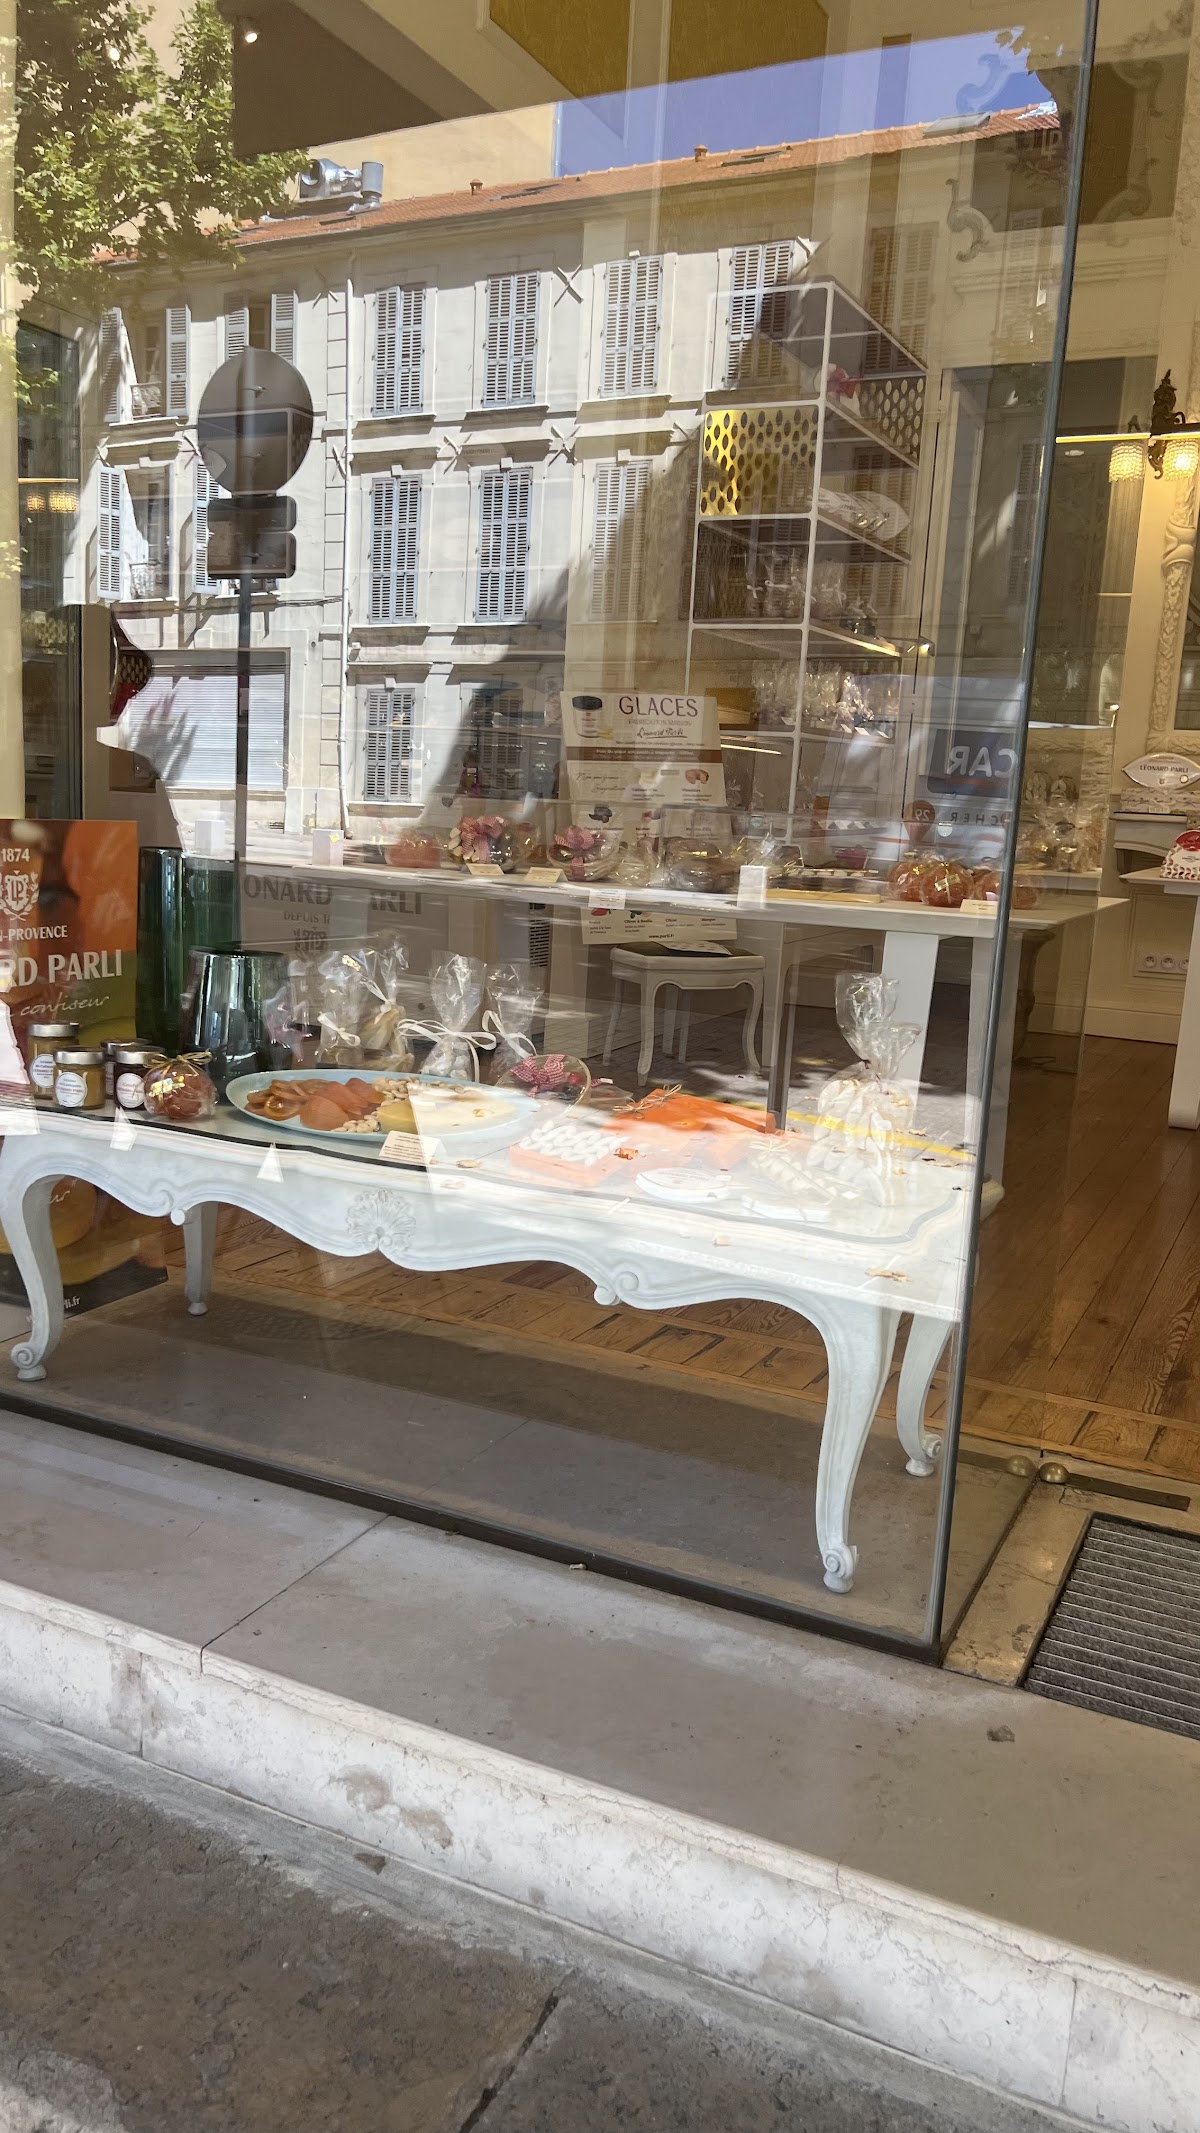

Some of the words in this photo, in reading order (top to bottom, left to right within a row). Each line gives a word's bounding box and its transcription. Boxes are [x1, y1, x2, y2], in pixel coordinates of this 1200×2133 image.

[619, 696, 698, 717] GLACES
[1, 848, 30, 862] 1874
[283, 910, 320, 923] DEPUIS
[48, 949, 122, 984] PARLI
[20, 991, 110, 1021] confiseur
